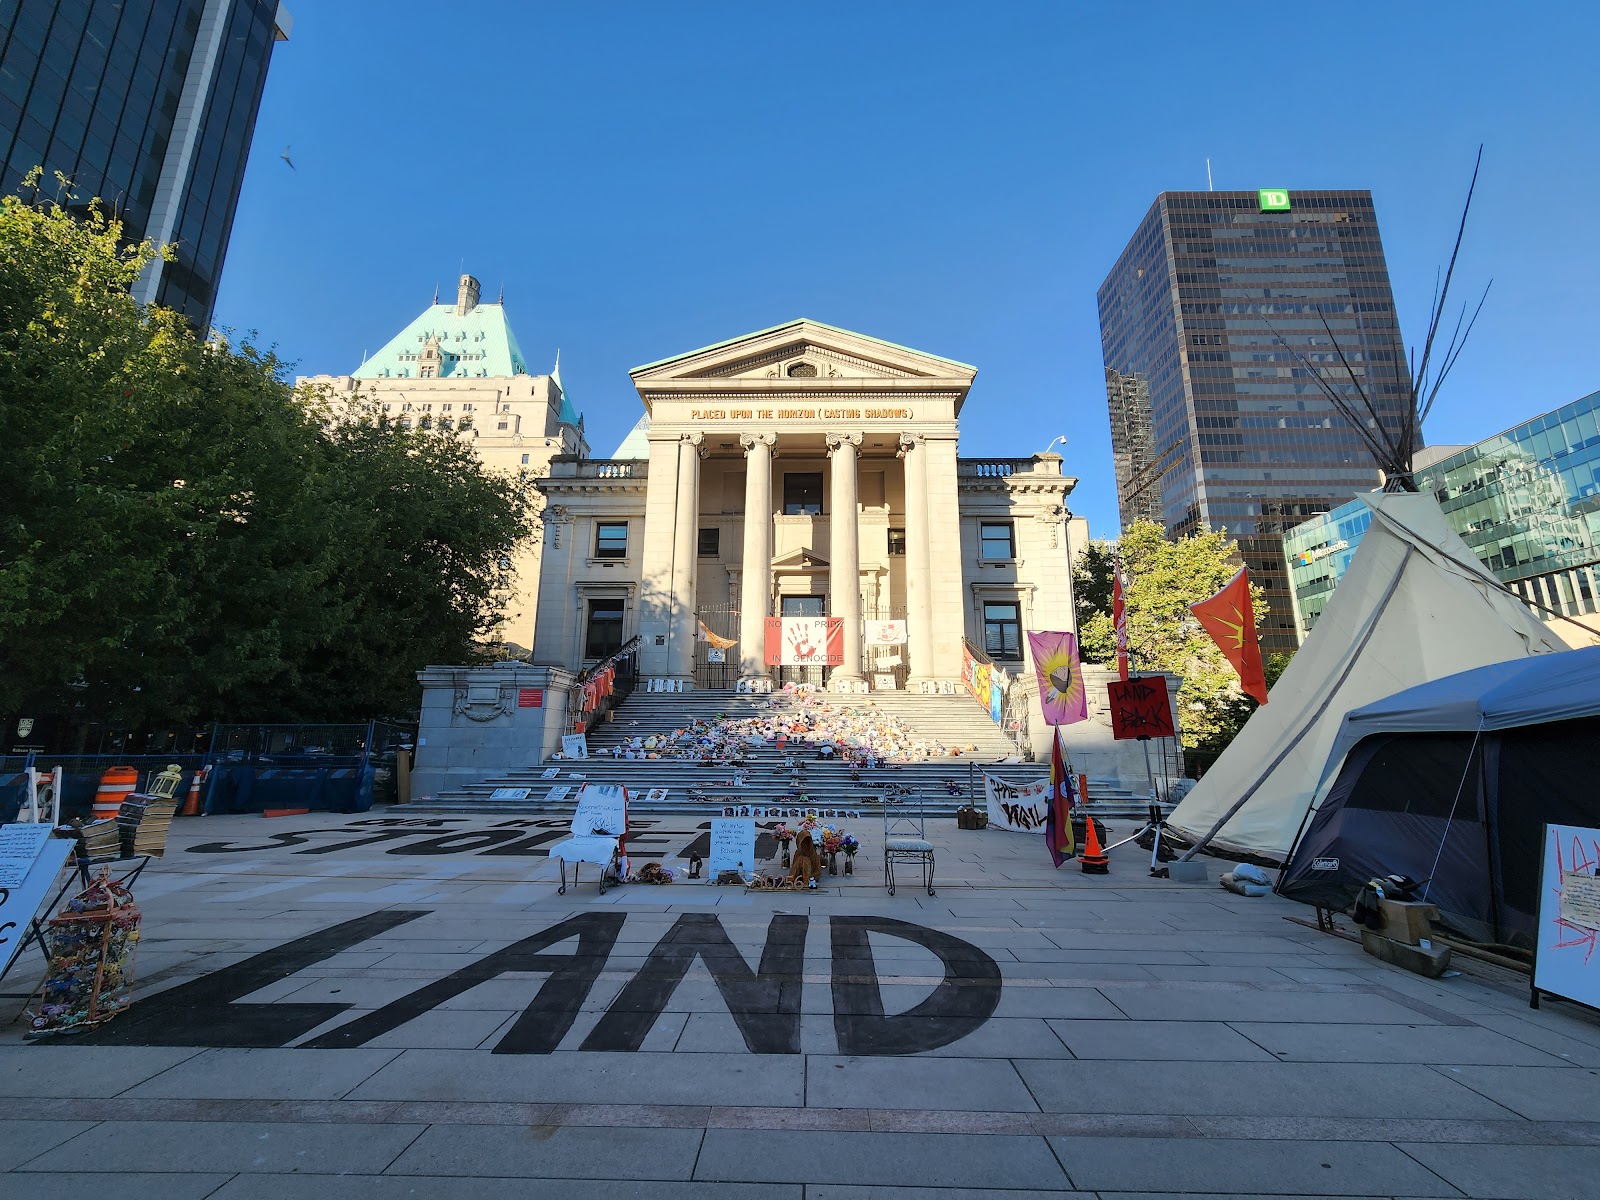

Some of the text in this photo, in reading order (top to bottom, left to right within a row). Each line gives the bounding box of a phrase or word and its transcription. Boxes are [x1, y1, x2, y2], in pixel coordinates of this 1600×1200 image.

[1262, 192, 1287, 206] TD
[691, 409, 726, 419] PLACED
[730, 409, 753, 419] UPON
[756, 409, 773, 419] THE
[778, 409, 815, 419] HORIZON
[1311, 540, 1349, 562] Microsoft
[768, 620, 782, 628] NO
[772, 654, 843, 662] IN GENOCIDE
[1113, 685, 1156, 702] LAND
[1119, 702, 1170, 733] BACK
[990, 778, 1019, 799] THE
[488, 819, 661, 829] HOE
[1001, 802, 1047, 830] VIGIL
[28, 911, 1002, 1056] LAND
